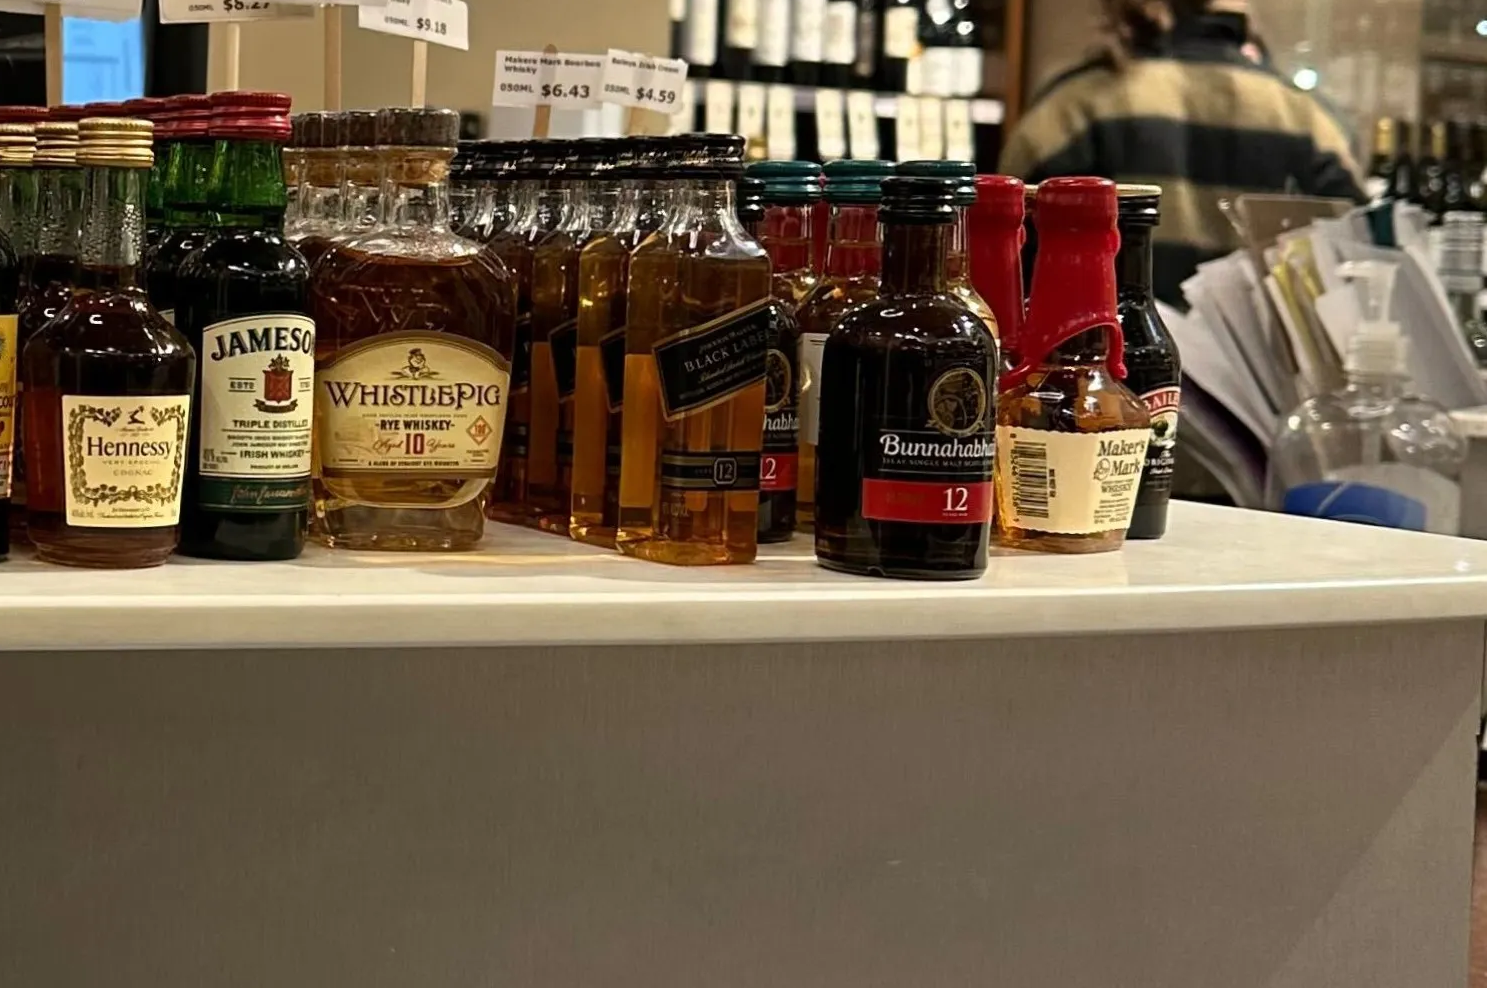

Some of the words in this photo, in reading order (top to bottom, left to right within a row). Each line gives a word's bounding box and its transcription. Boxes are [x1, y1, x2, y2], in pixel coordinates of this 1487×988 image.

[416, 17, 447, 35] $9.18
[541, 83, 591, 99] $6.43
[635, 86, 676, 104] $4.59
[210, 326, 315, 362] JAMESO
[684, 347, 730, 373] BLACK
[323, 379, 501, 411] WHISTLEPIG
[232, 419, 270, 429] TRIPLE
[380, 419, 401, 431] RYE
[403, 419, 452, 431] WHISKEY
[86, 436, 174, 460] Hennessy
[405, 432, 426, 455] 10
[1097, 439, 1146, 457] Maker's
[239, 449, 269, 459] IRISH
[717, 463, 733, 480] 12
[1109, 458, 1141, 477] Mark
[942, 487, 969, 512] 12
